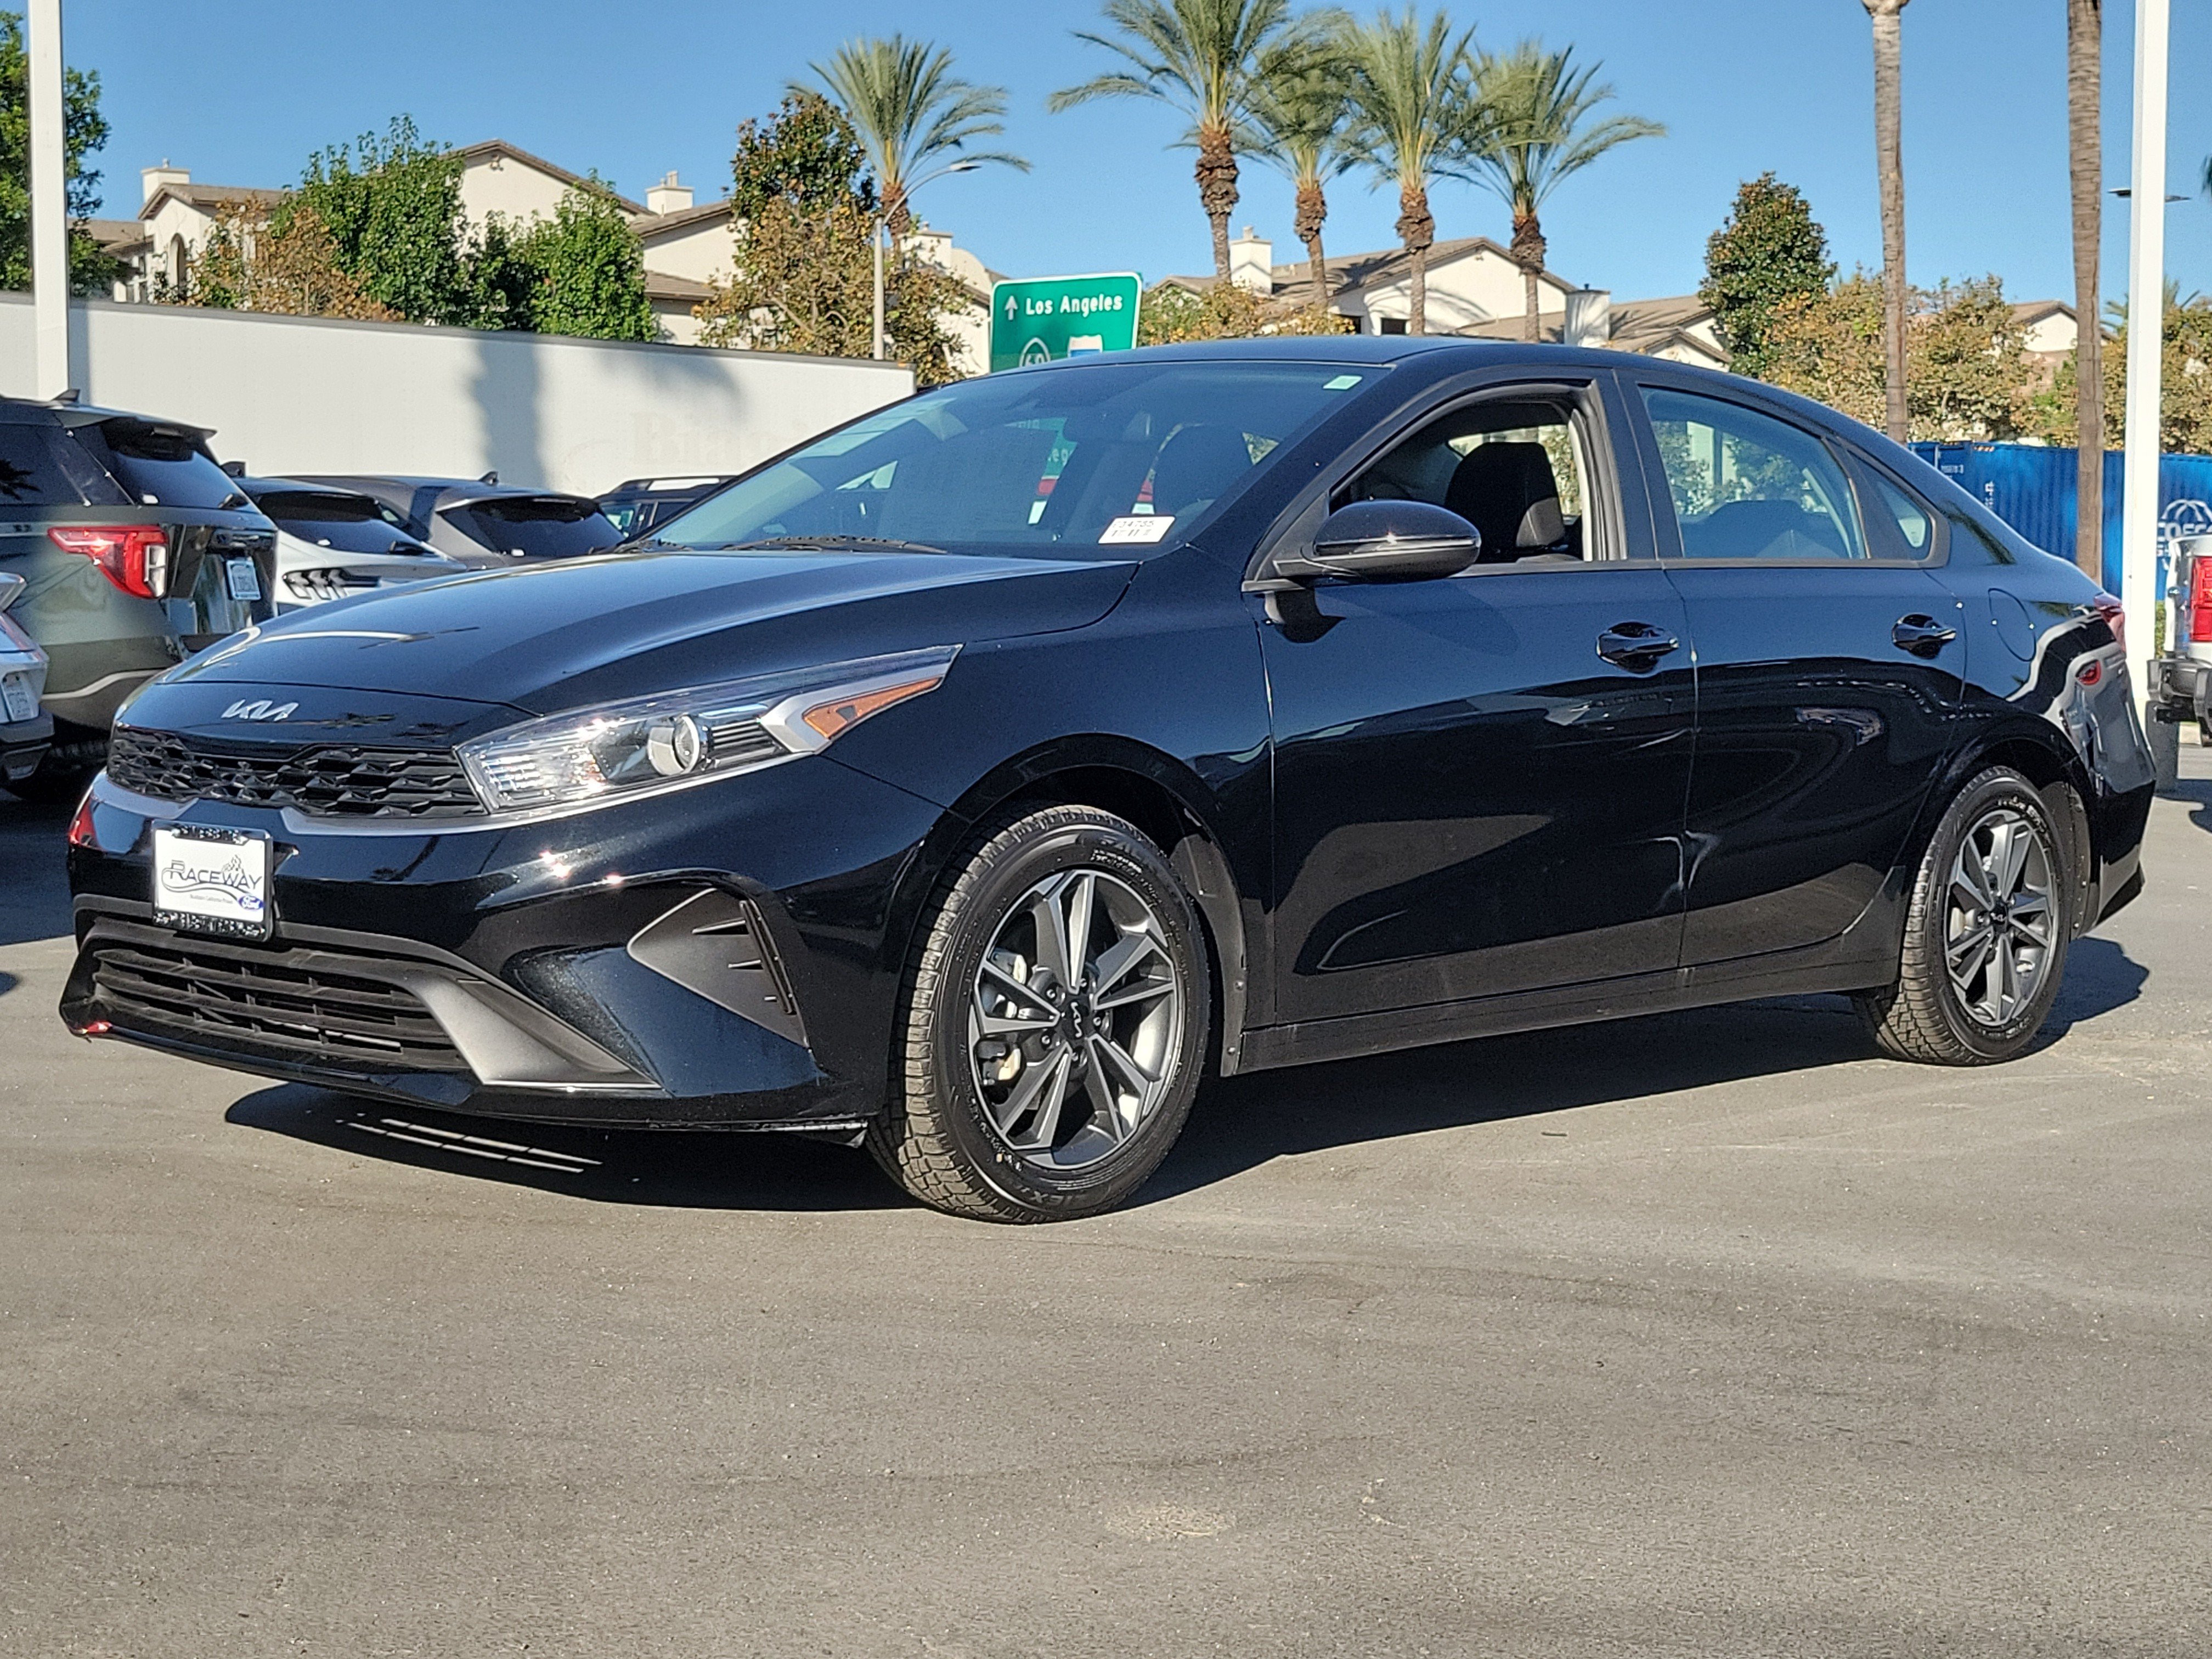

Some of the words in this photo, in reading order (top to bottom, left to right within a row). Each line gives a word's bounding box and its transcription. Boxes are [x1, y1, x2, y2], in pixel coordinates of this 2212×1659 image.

[1026, 297, 1053, 315] Los
[1060, 294, 1122, 318] Angeles
[168, 859, 262, 890] RACEWAY
